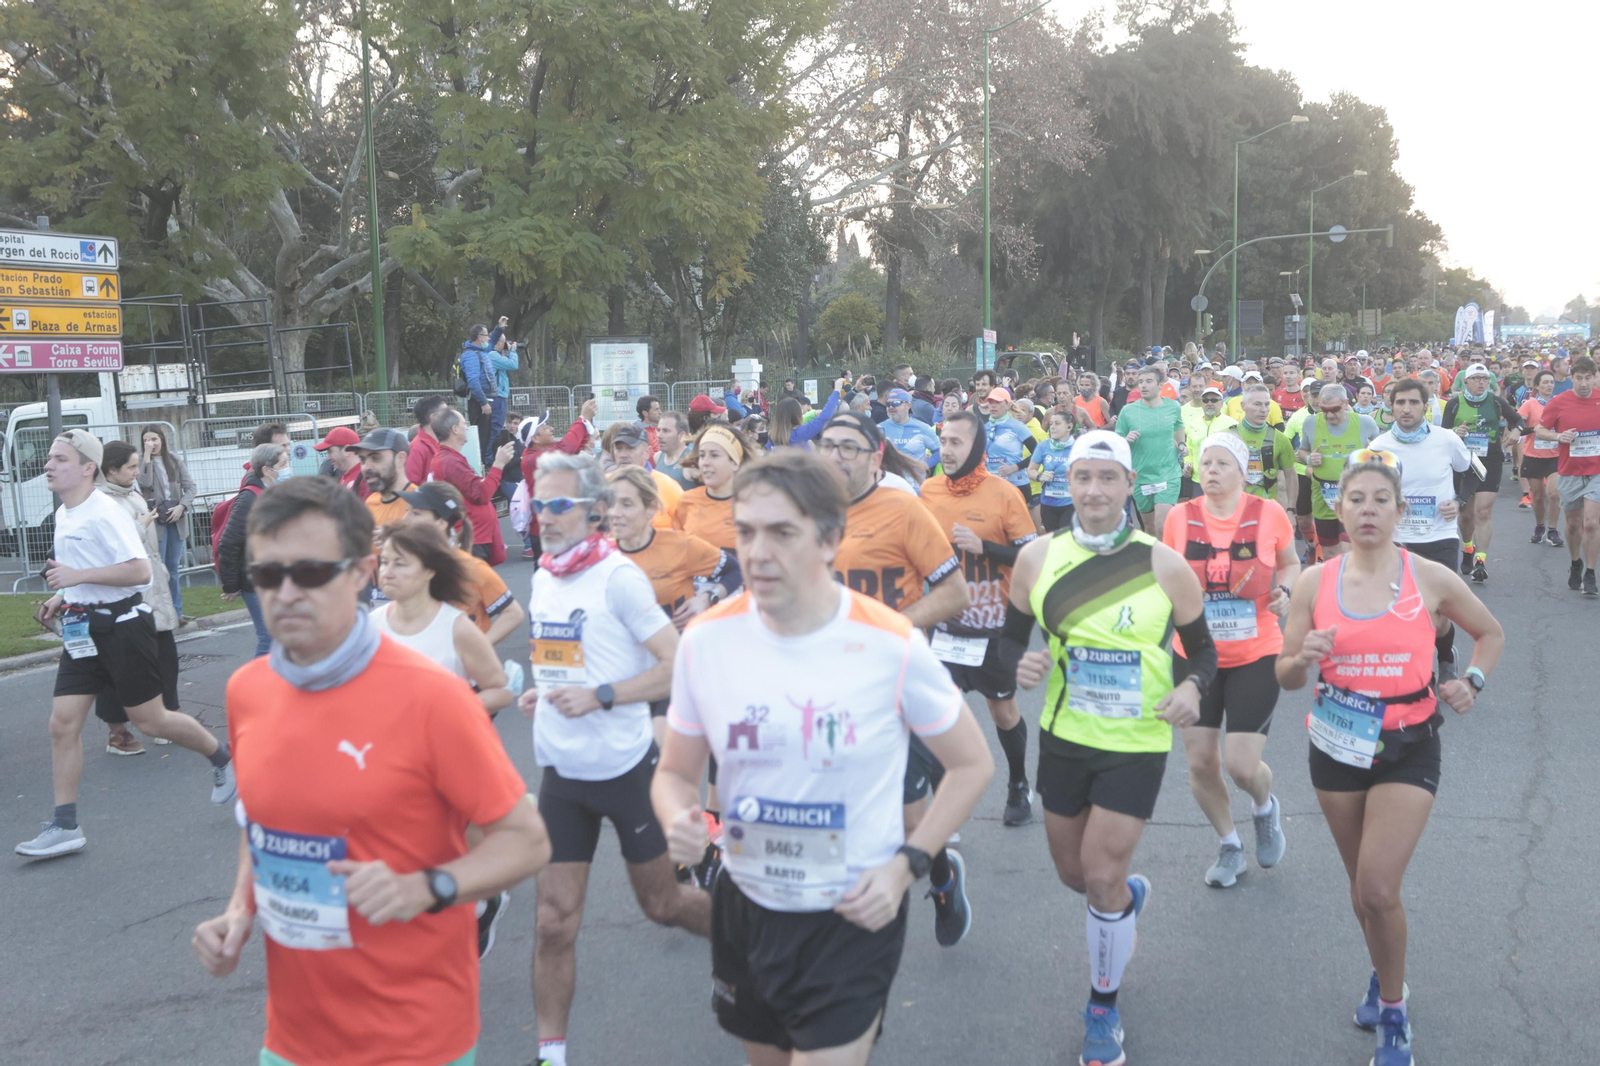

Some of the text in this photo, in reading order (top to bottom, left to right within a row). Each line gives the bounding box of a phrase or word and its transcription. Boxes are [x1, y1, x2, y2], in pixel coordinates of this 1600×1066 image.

[30, 248, 46, 258] del
[33, 273, 63, 284] Prado
[19, 285, 71, 297] Sebastián
[83, 310, 117, 319] estación
[32, 321, 118, 333] Plaza de Armas
[52, 344, 118, 355] Caixa Forum
[50, 357, 119, 368] Torre Sevilla
[241, 432, 254, 440] AMS
[961, 604, 1005, 629] 2022
[1211, 608, 1237, 618] 11001
[1212, 621, 1238, 629] GAËLLE
[543, 626, 575, 638] ZURICH
[1089, 651, 1132, 663] ZURICH
[1364, 653, 1380, 663] DEL
[1337, 665, 1362, 676] ESTOY
[1363, 666, 1375, 676] DE
[1334, 691, 1376, 713] ZURICH
[745, 706, 770, 722] 32
[1327, 711, 1354, 731] 11761
[1314, 720, 1358, 747] JENNIFER
[763, 805, 831, 826] ZURICH
[265, 835, 330, 859] ZURICH
